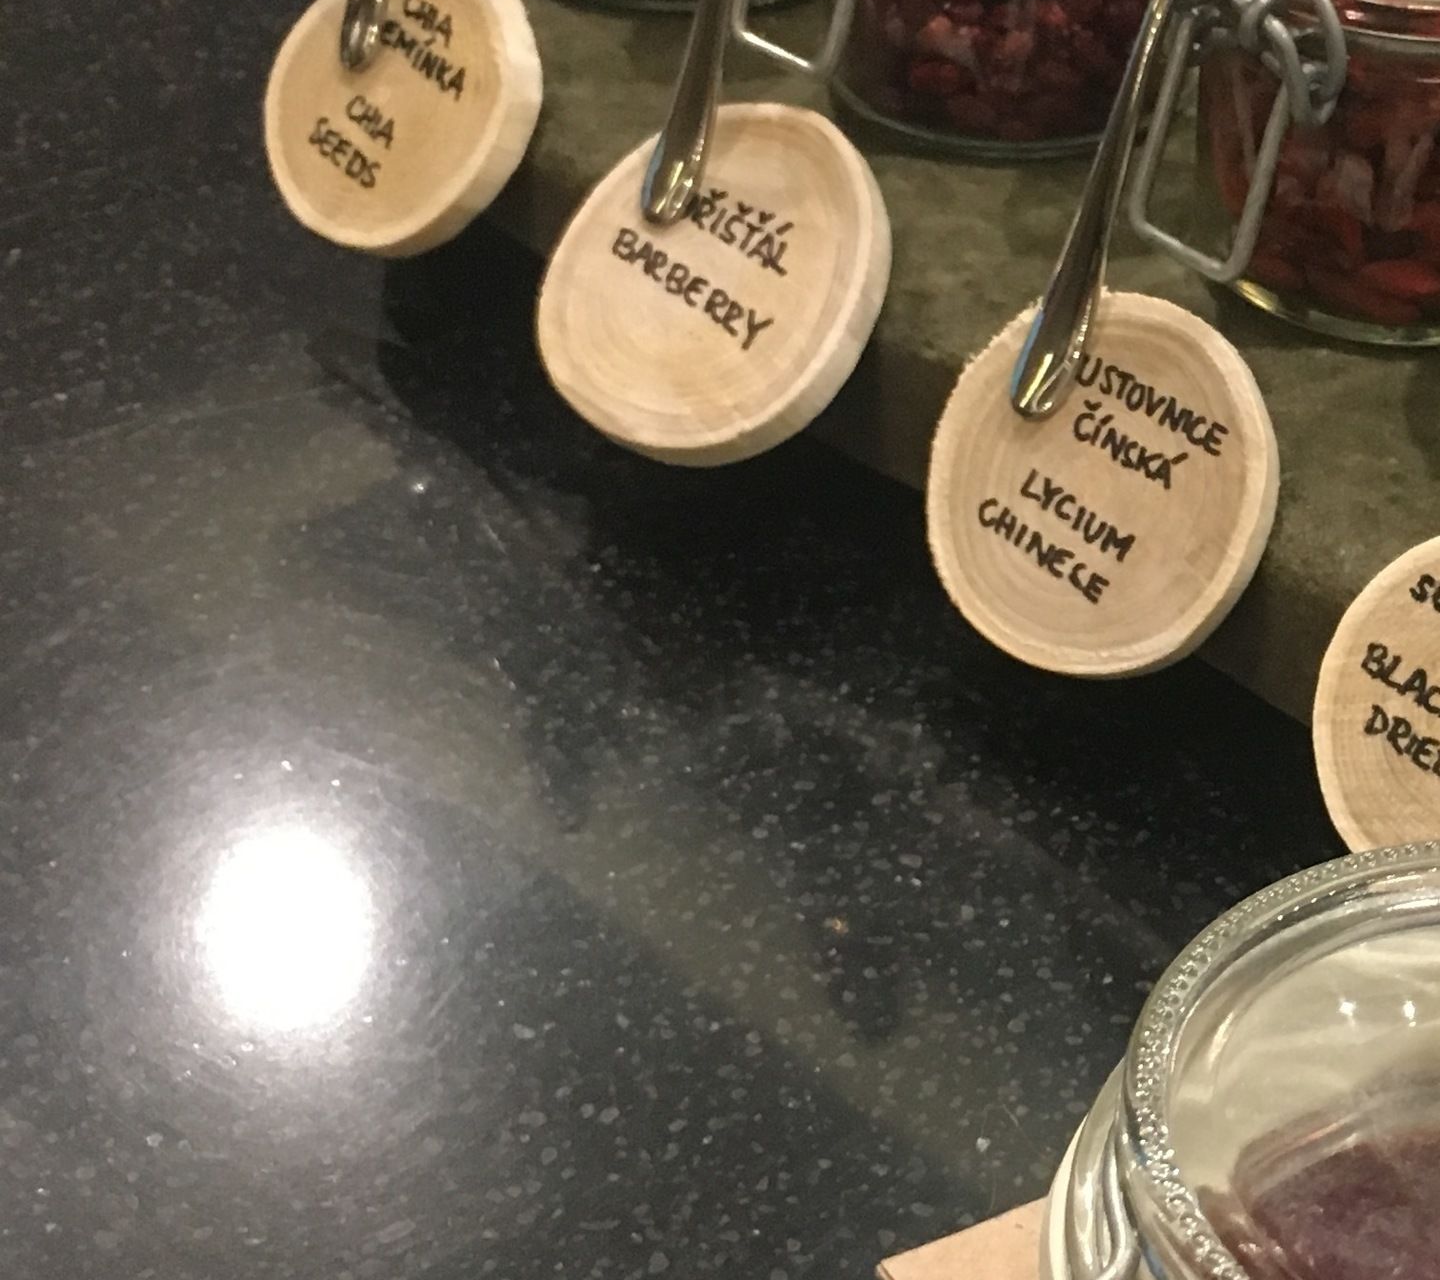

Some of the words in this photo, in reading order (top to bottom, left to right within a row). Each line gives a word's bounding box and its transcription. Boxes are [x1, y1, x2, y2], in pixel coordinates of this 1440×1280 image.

[380, 19, 467, 102] EMÍNKA
[308, 116, 383, 189] SEEDS
[346, 94, 395, 161] CHIA
[686, 188, 795, 277] ŘIŠŤÁL
[611, 227, 775, 351] BARBERRY
[1072, 398, 1190, 491] ČÍNSKÁ
[1074, 352, 1230, 457] USTOVNICE
[1019, 467, 1137, 563] LYCIUM
